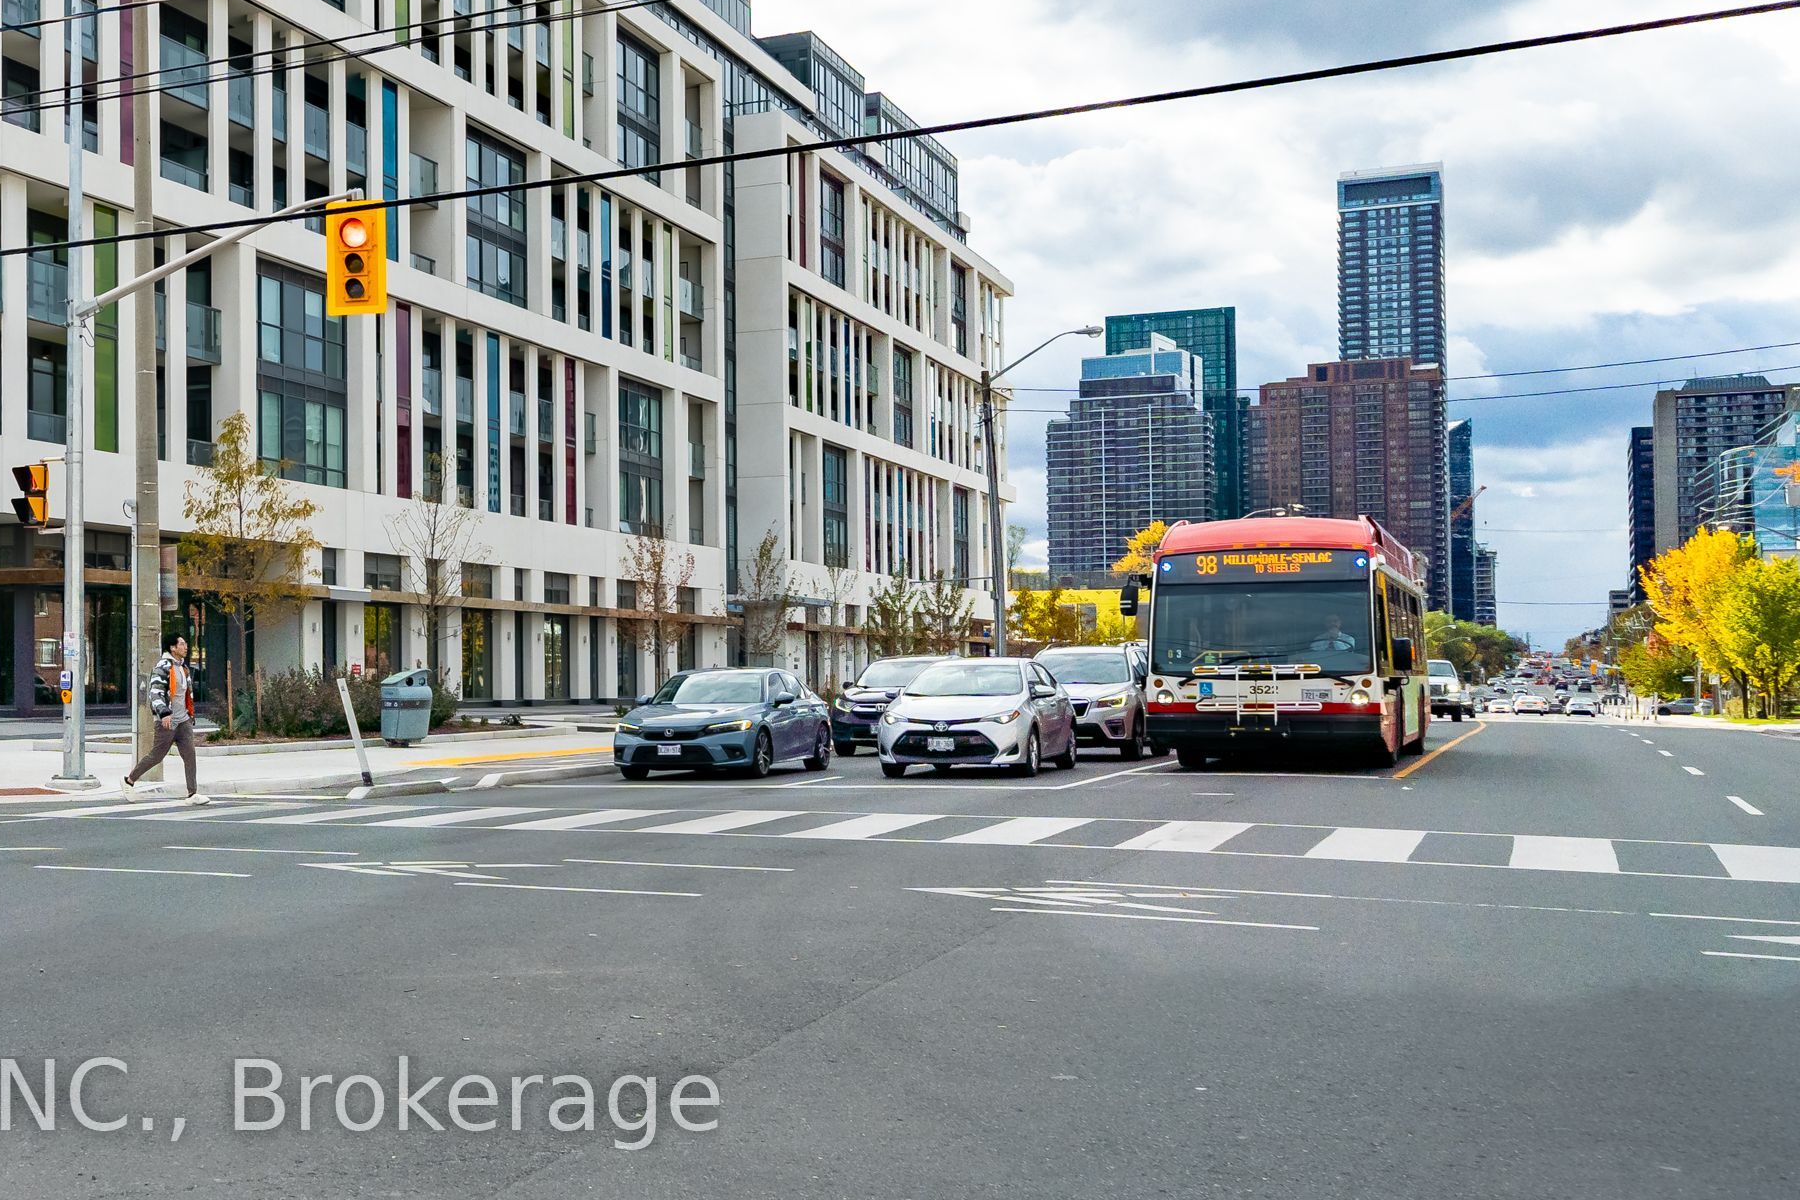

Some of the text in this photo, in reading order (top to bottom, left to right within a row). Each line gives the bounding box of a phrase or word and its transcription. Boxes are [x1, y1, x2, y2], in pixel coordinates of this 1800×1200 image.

[1196, 552, 1333, 575] 98 WILLOWDALE-SENLAC
[1267, 563, 1301, 573] STEELES
